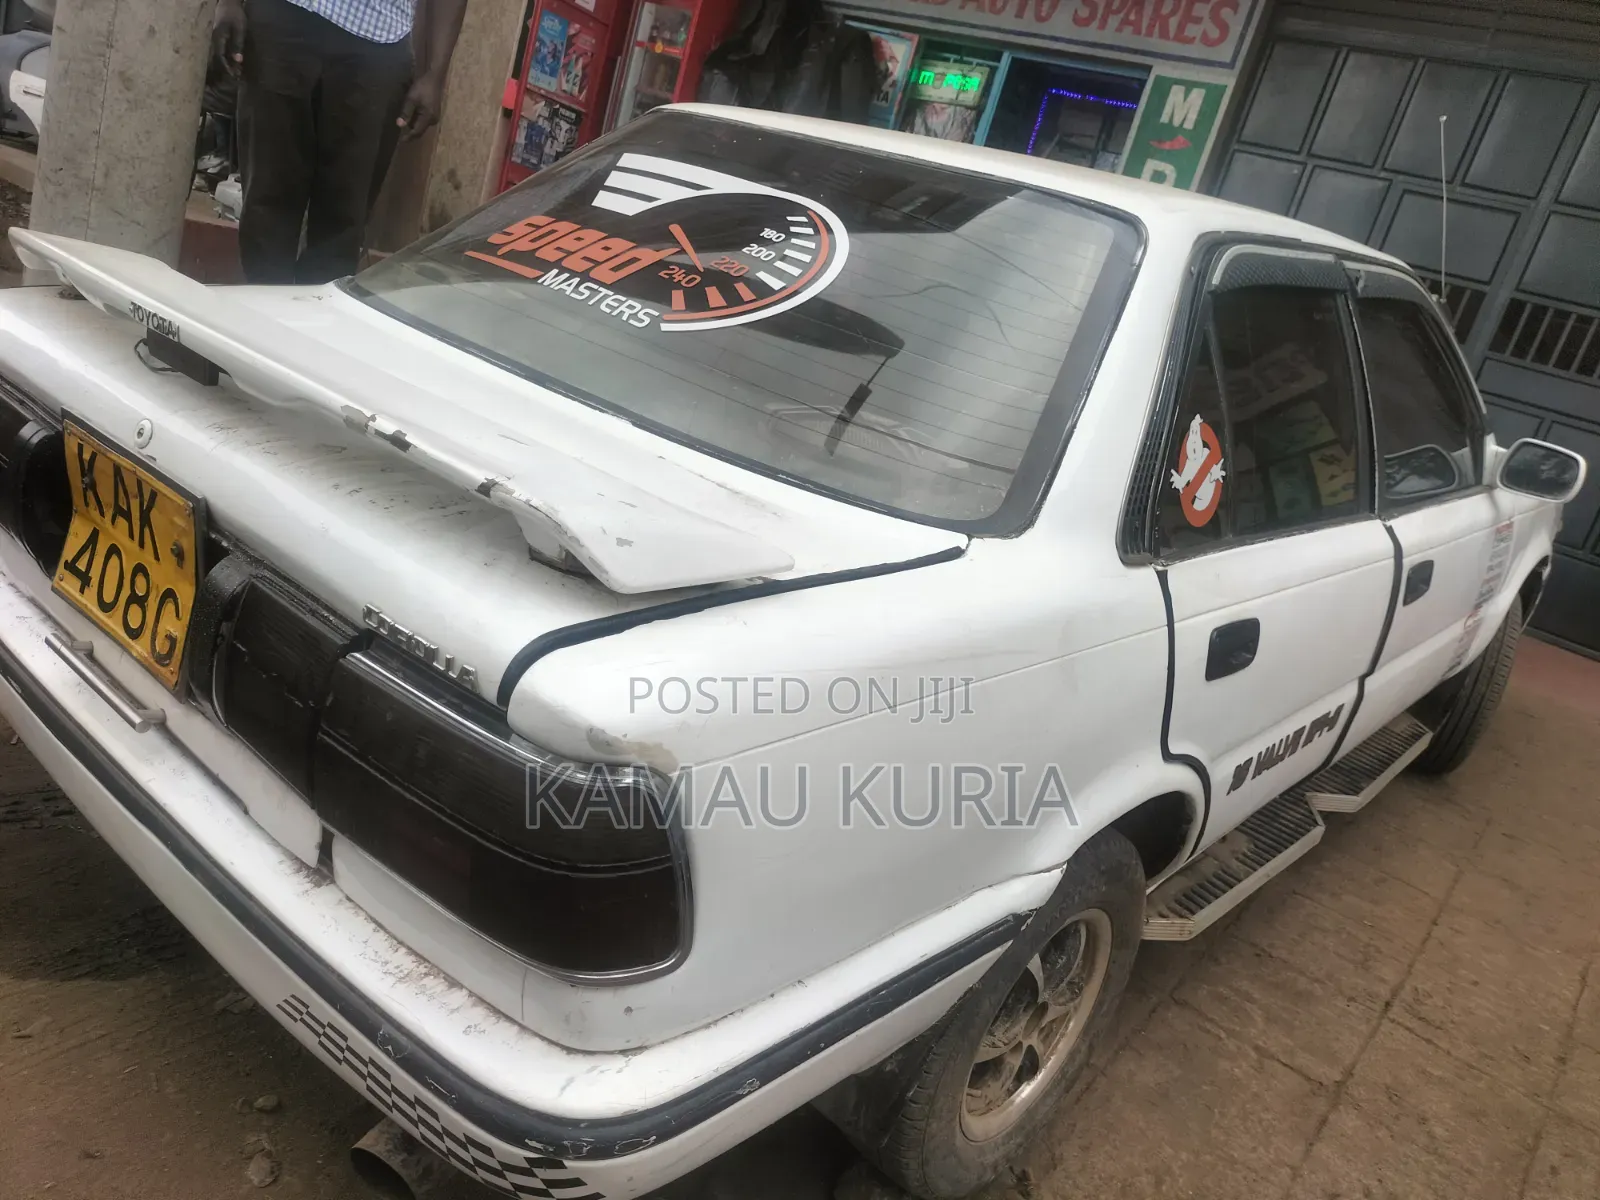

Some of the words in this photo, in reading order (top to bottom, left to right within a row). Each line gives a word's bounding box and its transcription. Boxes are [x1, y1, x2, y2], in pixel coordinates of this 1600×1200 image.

[1072, 0, 1240, 47] SPARES
[1159, 84, 1206, 130] M
[741, 243, 776, 261] 200
[760, 227, 786, 242] 180
[657, 265, 702, 288] 240
[709, 255, 750, 277] 220
[537, 268, 660, 328] MASTERS
[129, 300, 177, 340] TOYOTA
[77, 442, 160, 562] KAK
[63, 527, 181, 668] 408G
